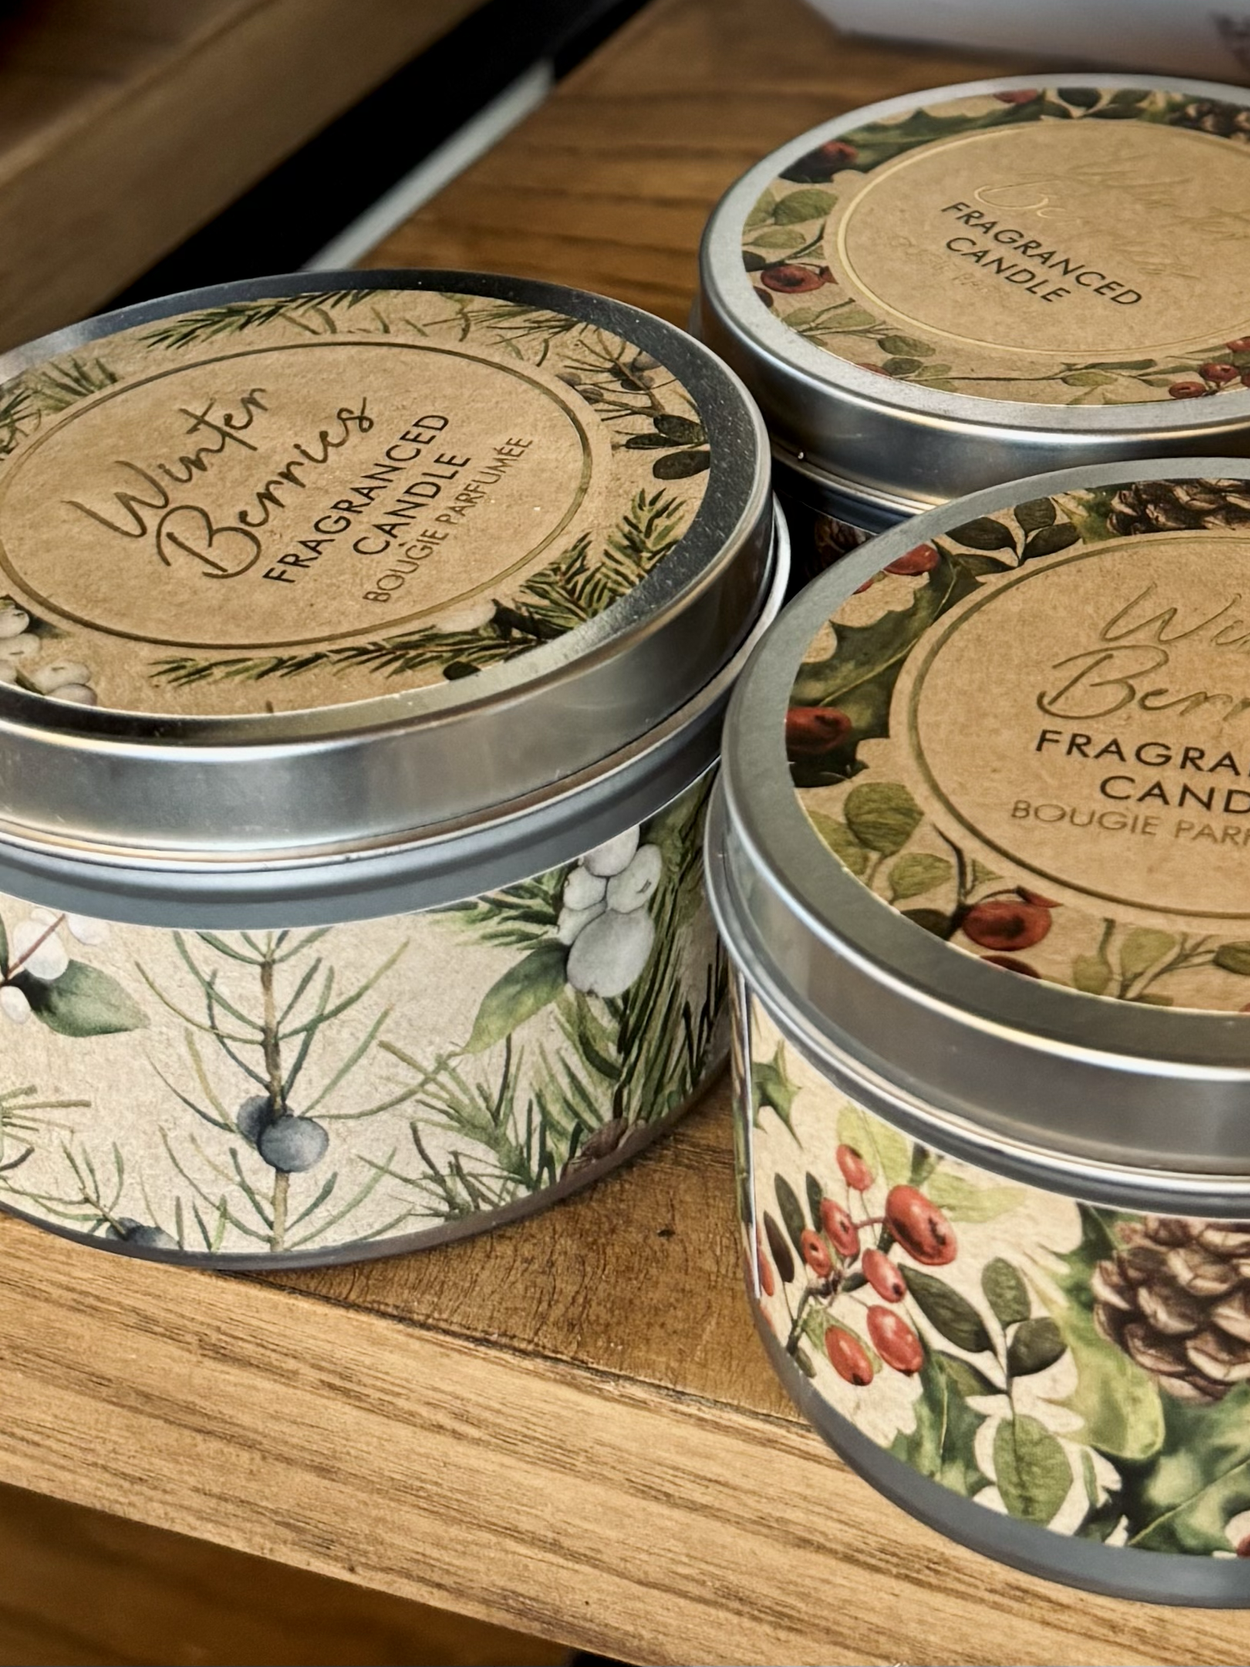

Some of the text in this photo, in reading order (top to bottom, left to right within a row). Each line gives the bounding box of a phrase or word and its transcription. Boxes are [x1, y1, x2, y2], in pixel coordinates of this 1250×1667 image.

[941, 201, 1143, 305] FRAGRANCED
[945, 236, 1071, 303] CANDLE
[61, 388, 268, 538] Winter
[156, 398, 374, 579] Berries
[263, 415, 449, 584] FRAGRANCED
[352, 453, 470, 556] CANDLE
[362, 437, 533, 604] BOUGIE PARFUMÉE
[1011, 799, 1160, 835] BOUGIE
